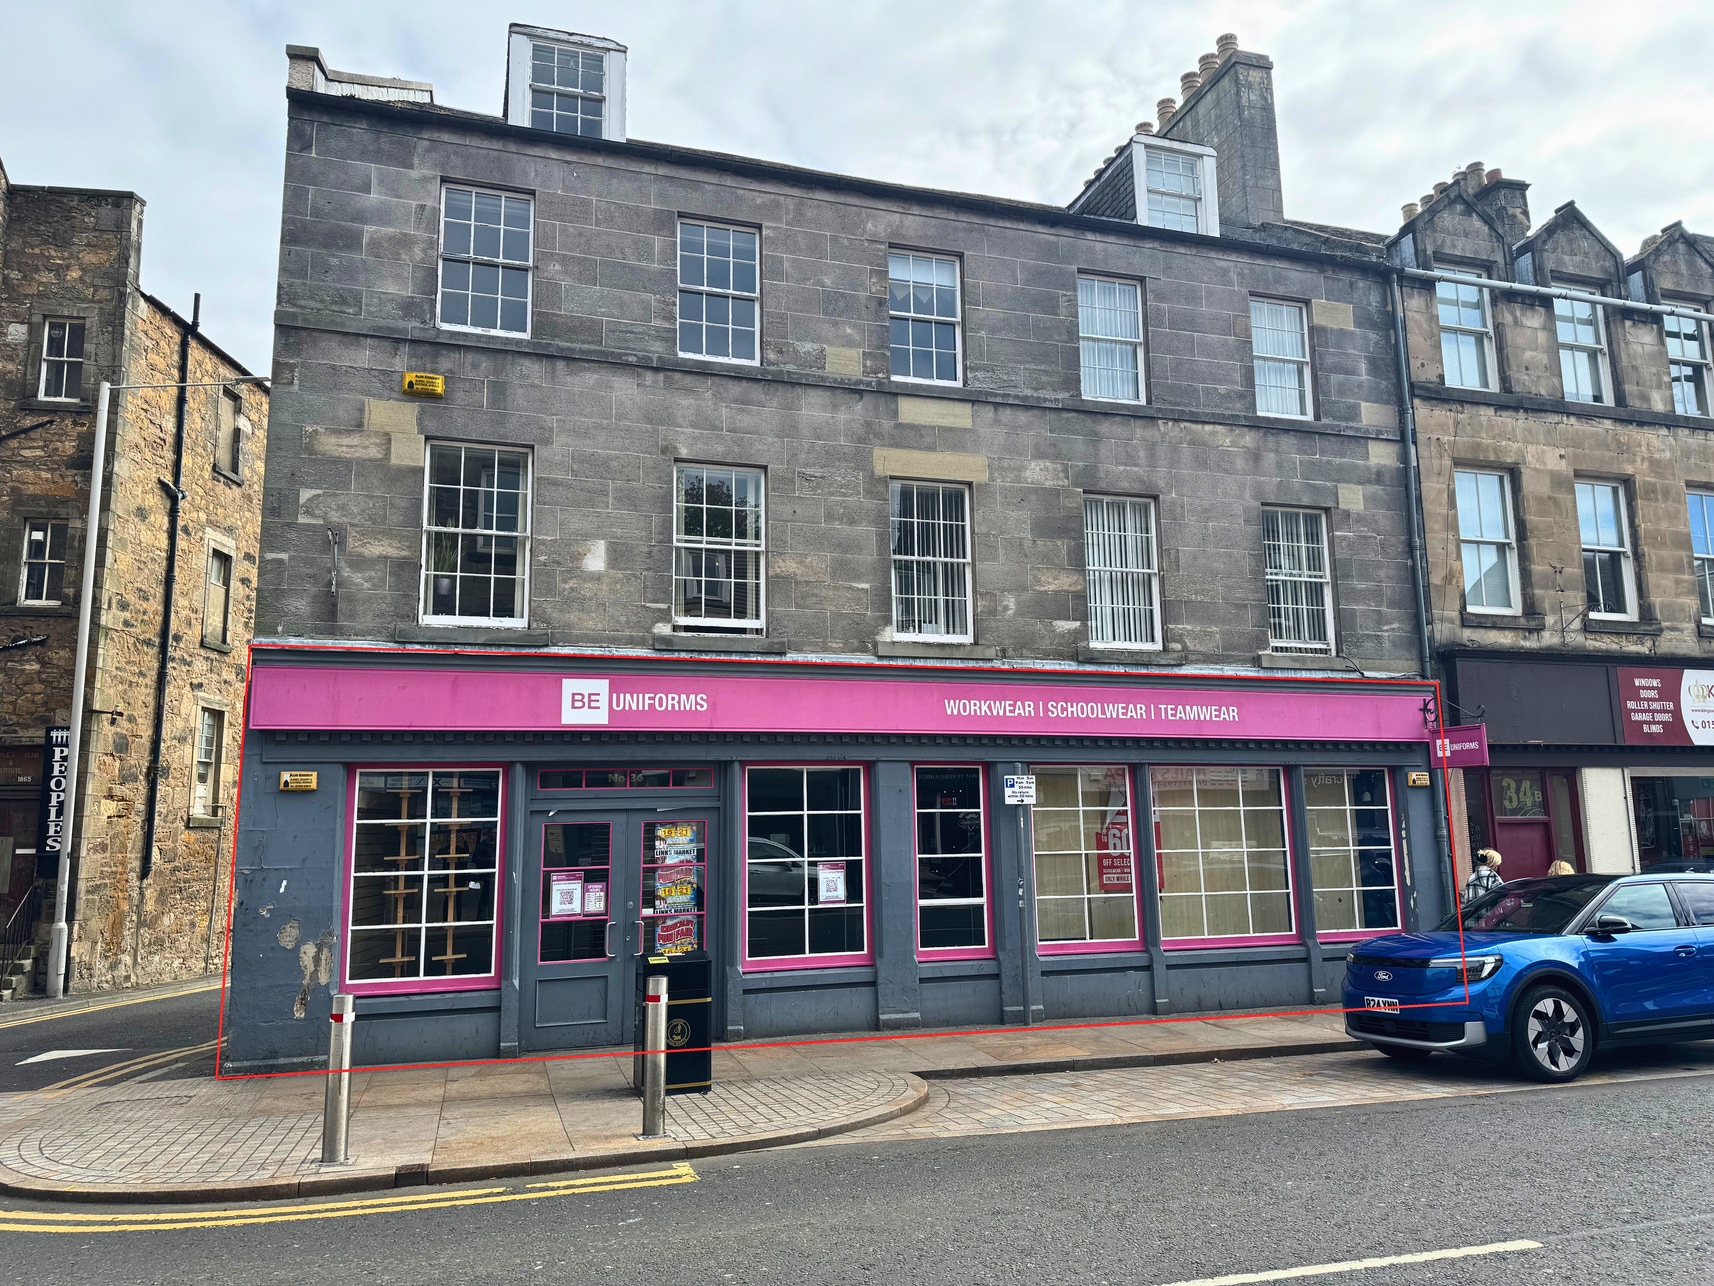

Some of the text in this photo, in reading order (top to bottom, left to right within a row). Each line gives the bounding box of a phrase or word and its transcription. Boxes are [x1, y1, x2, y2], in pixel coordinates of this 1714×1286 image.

[1634, 678, 1661, 687] WINDOWS
[1640, 690, 1658, 699] DOORS
[571, 692, 708, 711] BE UNIFORMS
[1627, 701, 1674, 710] ROLLER SHUTTER
[945, 699, 1035, 717] WORKWEAR
[1048, 701, 1146, 719] SCHOOLWEAR
[1158, 704, 1239, 722] TEAMWEAR
[1631, 713, 1673, 721] GARAGE DOORS
[1643, 724, 1664, 733] BLINDS
[1450, 741, 1479, 751] UNIFORMS
[630, 773, 644, 783] 36
[45, 746, 69, 851] PEOPLES
[1103, 858, 1112, 866] OFF
